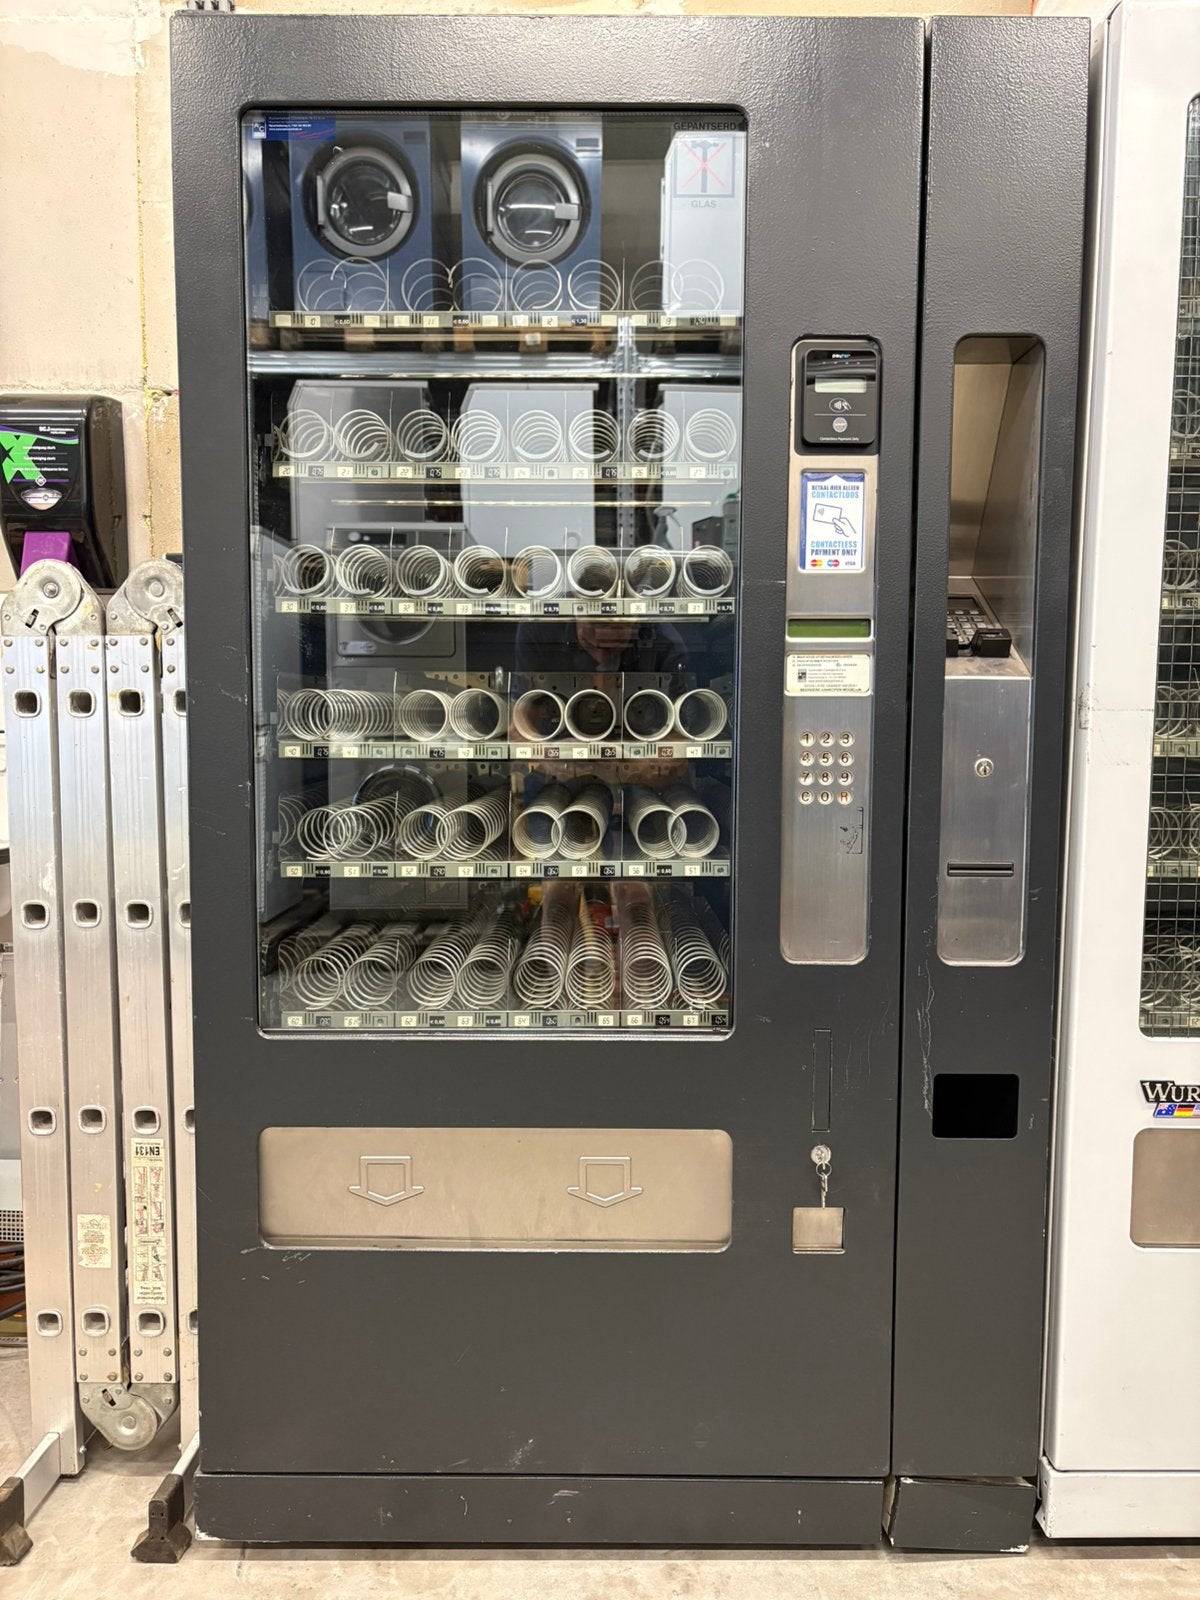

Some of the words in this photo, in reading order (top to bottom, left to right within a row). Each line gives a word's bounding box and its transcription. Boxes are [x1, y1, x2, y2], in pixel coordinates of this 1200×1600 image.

[674, 122, 736, 130] GEPANTSERD
[691, 200, 717, 208] GLAS
[810, 540, 858, 548] CONTACTLESS
[804, 734, 809, 744] 1
[822, 733, 830, 744] 2
[842, 734, 850, 744] 3
[802, 752, 810, 763] 4
[822, 752, 830, 763] 5
[841, 752, 849, 763] 6
[802, 772, 810, 782] 7
[822, 772, 829, 782] 8
[840, 772, 849, 782] 9
[802, 792, 810, 802] C
[820, 792, 830, 802] 0
[136, 1146, 160, 1156] EN131
